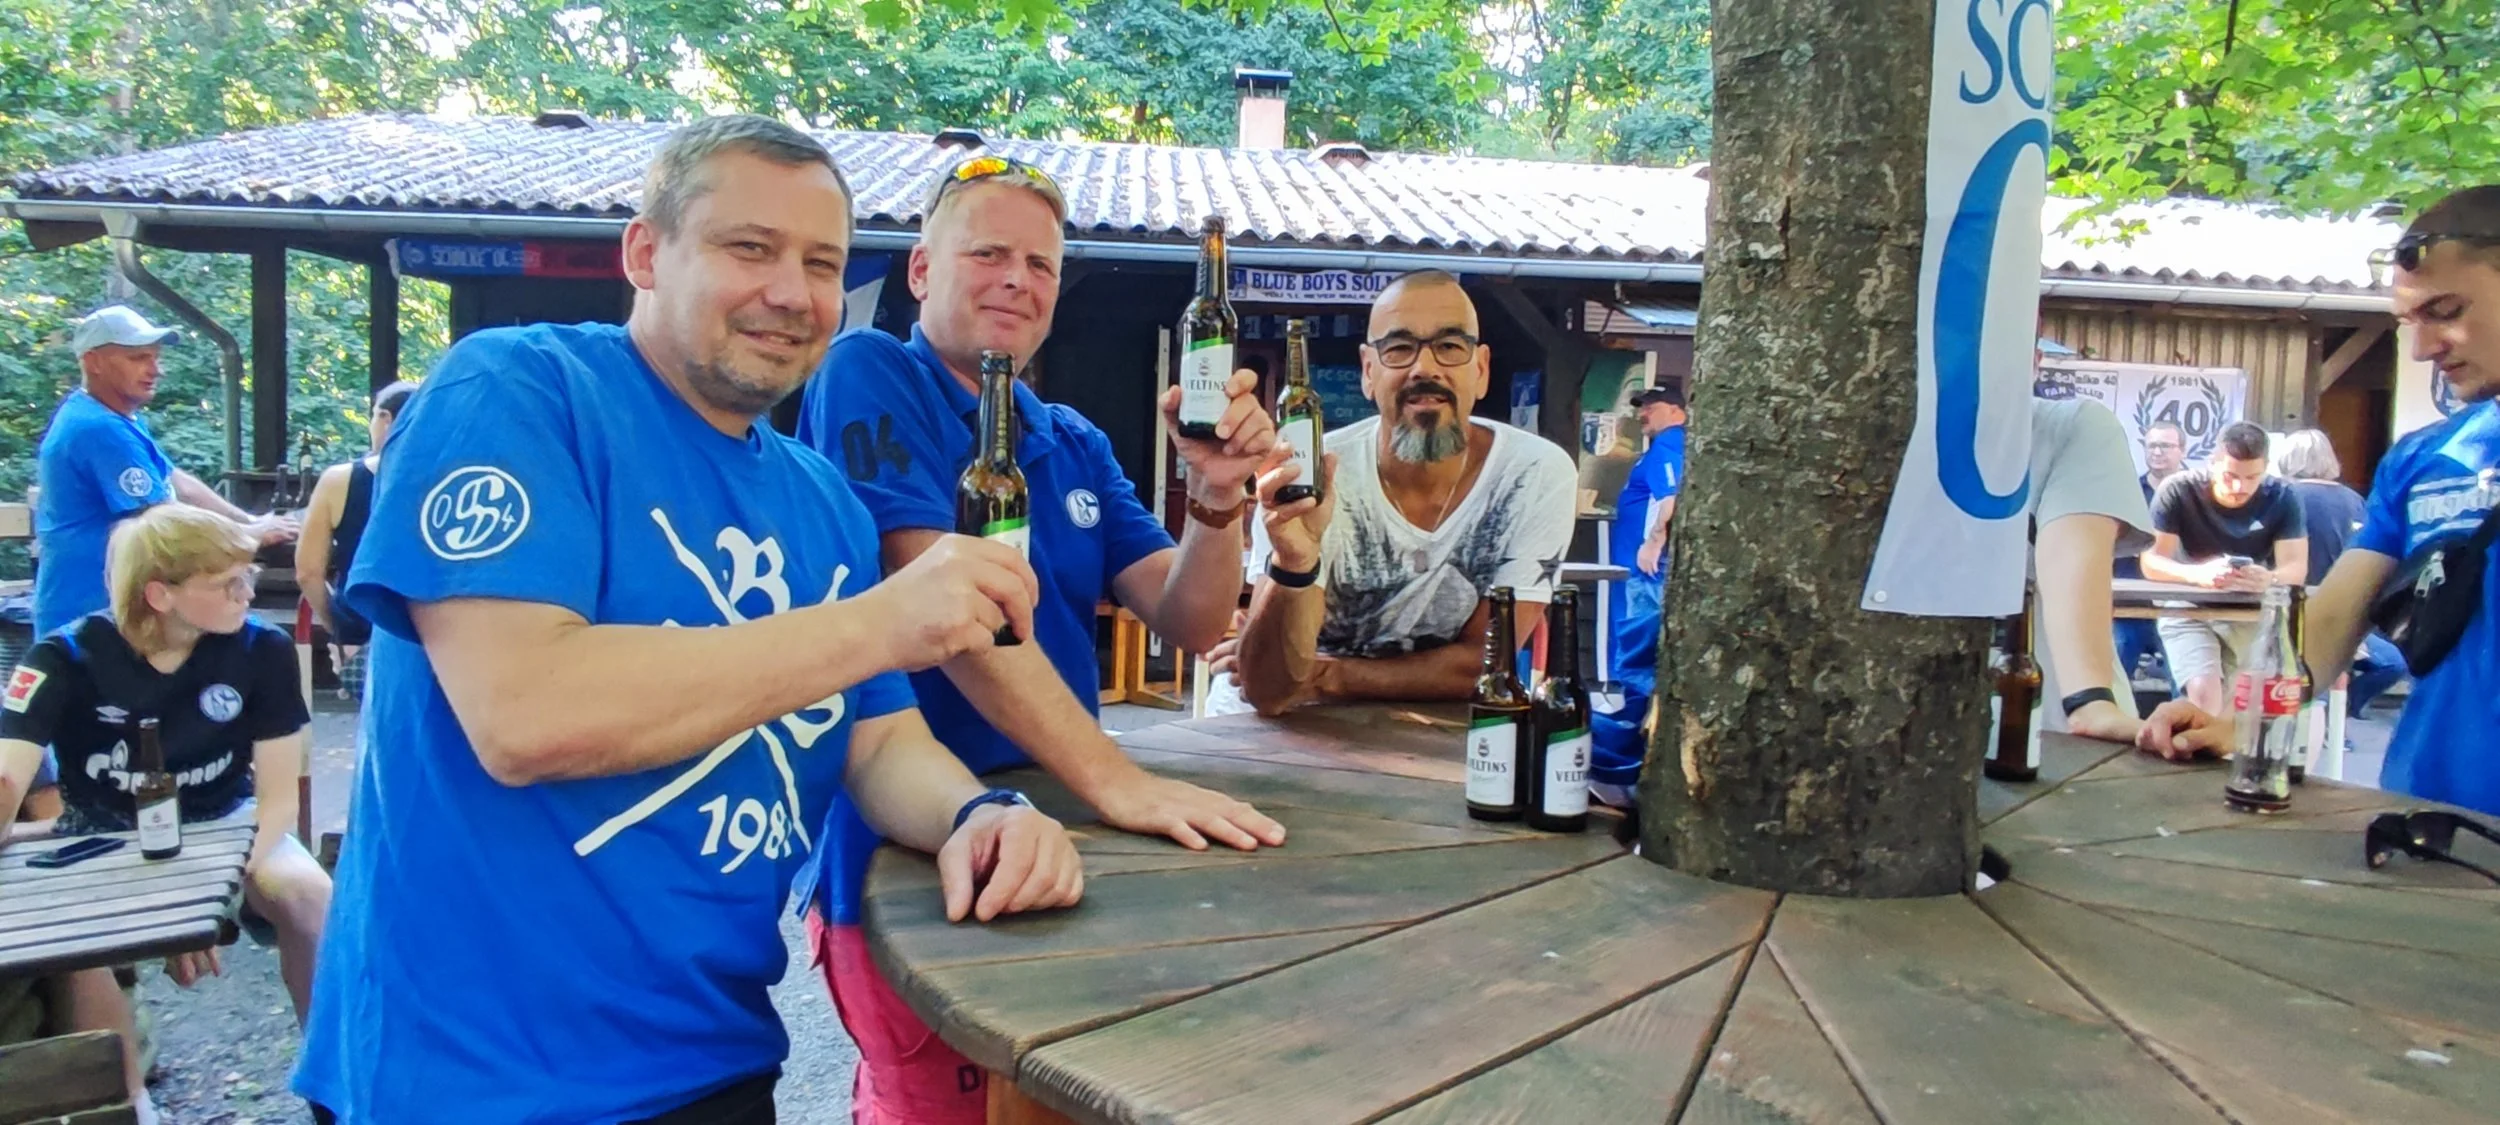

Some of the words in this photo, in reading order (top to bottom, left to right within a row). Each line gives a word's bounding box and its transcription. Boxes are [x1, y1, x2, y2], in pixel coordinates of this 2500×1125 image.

[1252, 271, 1297, 290] BLUE
[1301, 273, 1347, 291] BOYS
[2170, 376, 2199, 387] 1981
[2154, 399, 2210, 437] 40
[841, 414, 913, 482] 04
